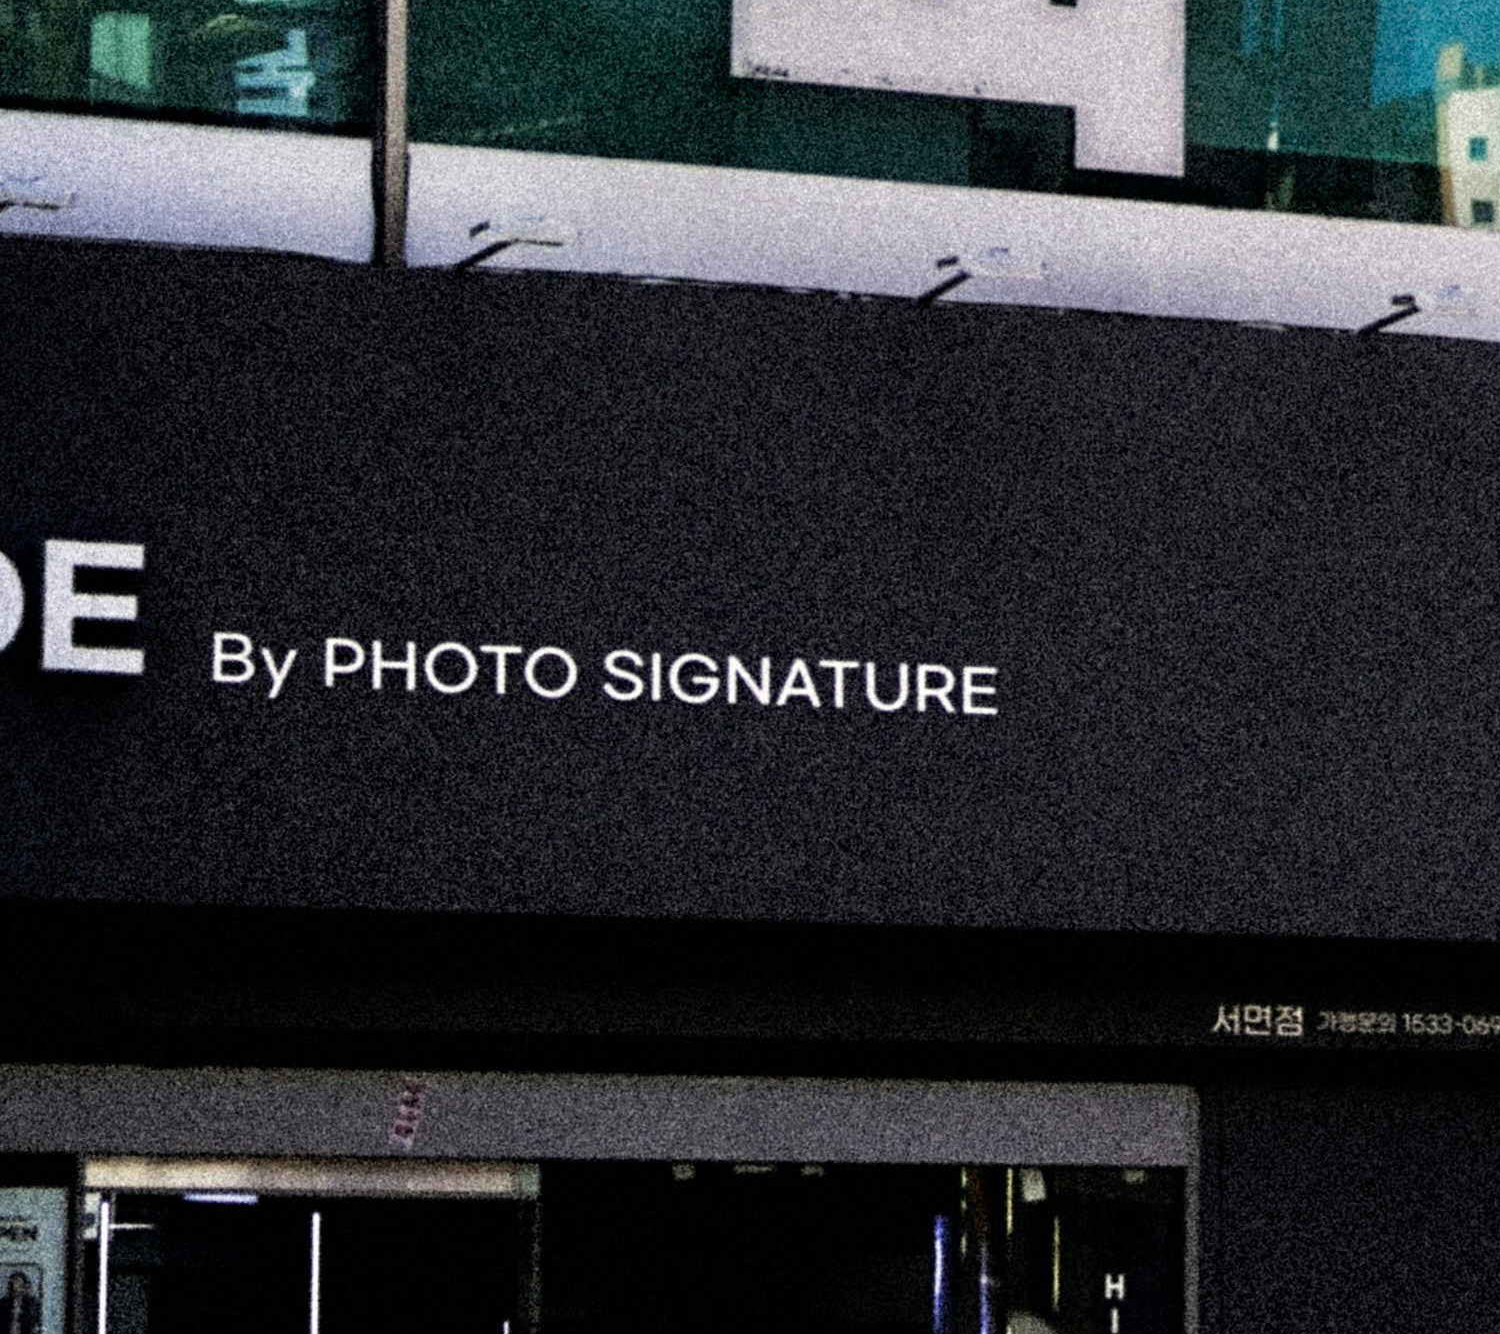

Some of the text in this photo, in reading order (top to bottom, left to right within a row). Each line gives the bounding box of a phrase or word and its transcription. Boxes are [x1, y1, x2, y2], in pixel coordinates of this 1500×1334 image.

[212, 633, 297, 698] By
[325, 639, 577, 698] PHOTO
[603, 651, 998, 715] SIGNATURE
[1212, 1004, 1303, 1037] 서면점
